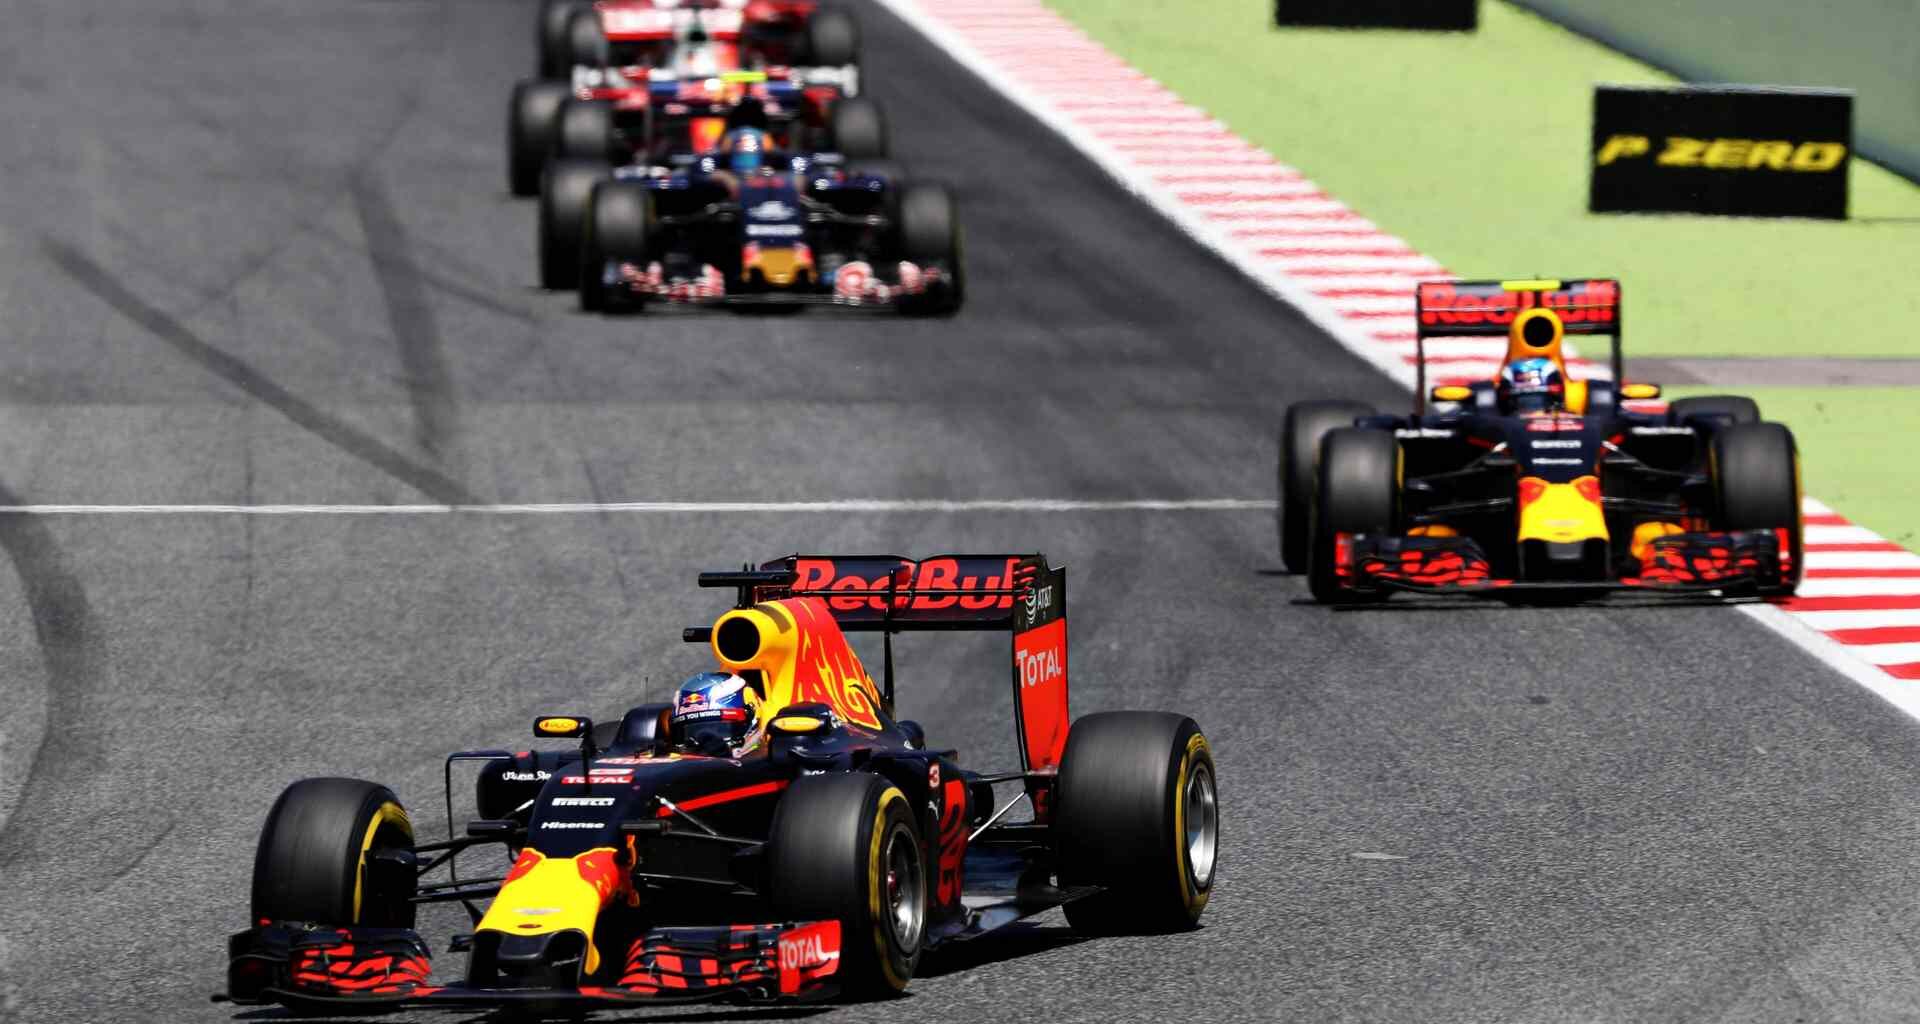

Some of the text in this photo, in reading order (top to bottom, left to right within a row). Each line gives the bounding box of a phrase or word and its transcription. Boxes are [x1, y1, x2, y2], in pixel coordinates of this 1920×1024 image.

[1599, 135, 1847, 172] P ZERO
[928, 762, 940, 788] 3
[551, 797, 616, 807] PIRELLI
[540, 821, 606, 830] Hisense
[778, 933, 841, 970] TOTAL
